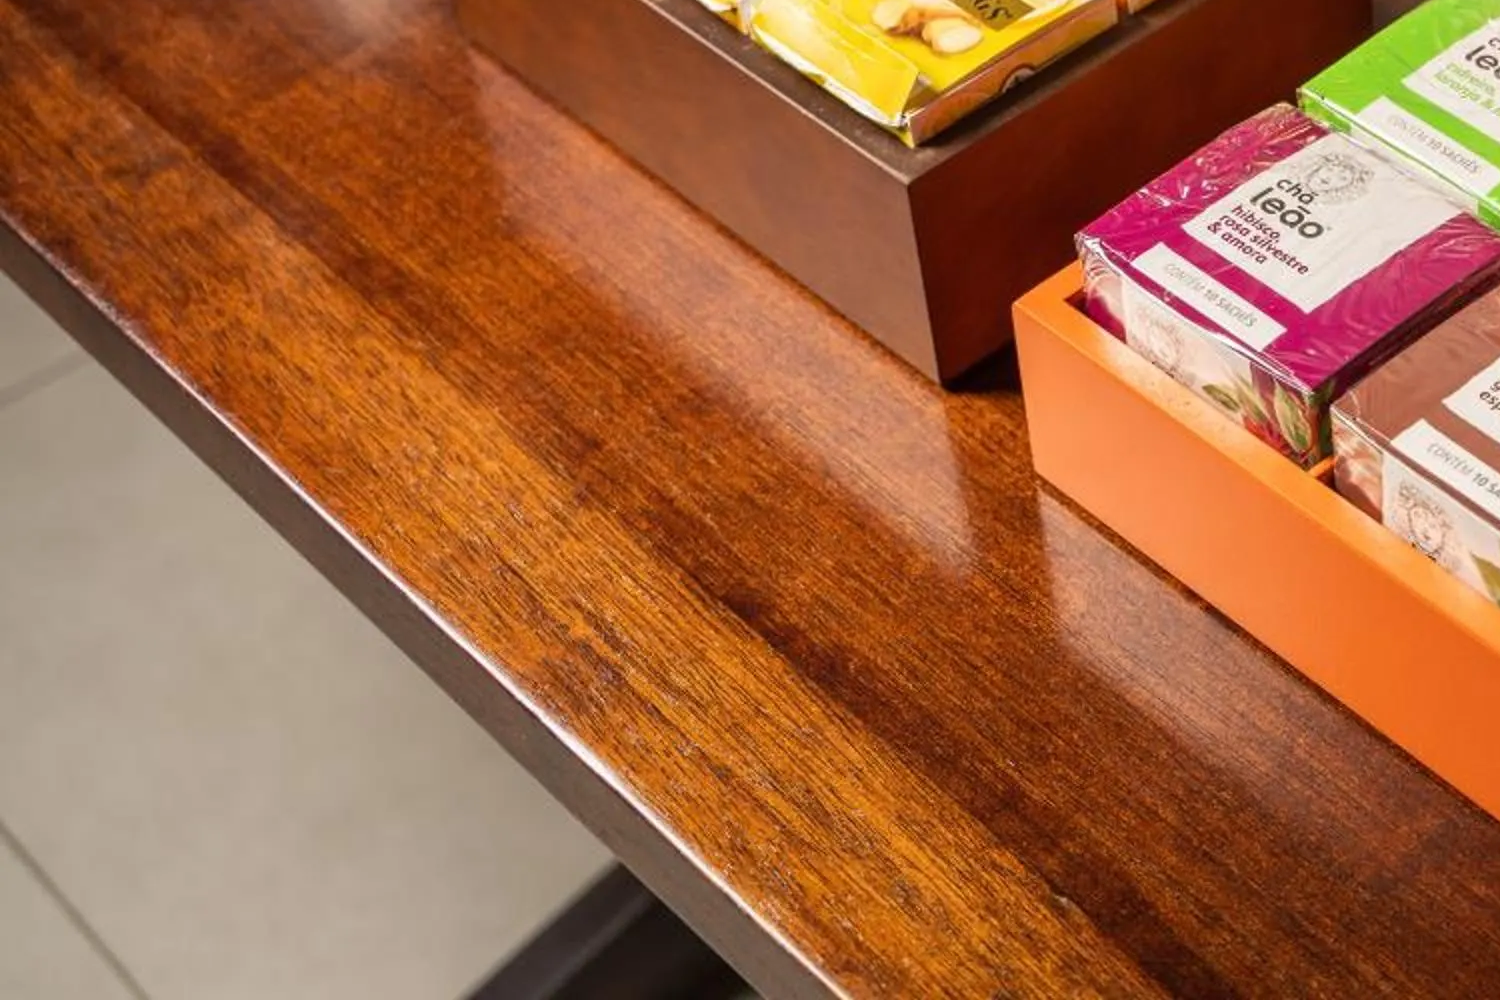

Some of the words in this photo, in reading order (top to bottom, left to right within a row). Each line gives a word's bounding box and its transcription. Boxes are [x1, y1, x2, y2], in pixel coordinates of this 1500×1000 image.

[1207, 221, 1222, 235] &
[1220, 231, 1267, 265] amora
[1220, 215, 1251, 237] rosa
[1250, 235, 1309, 275] silvestre
[1472, 472, 1490, 488] 10
